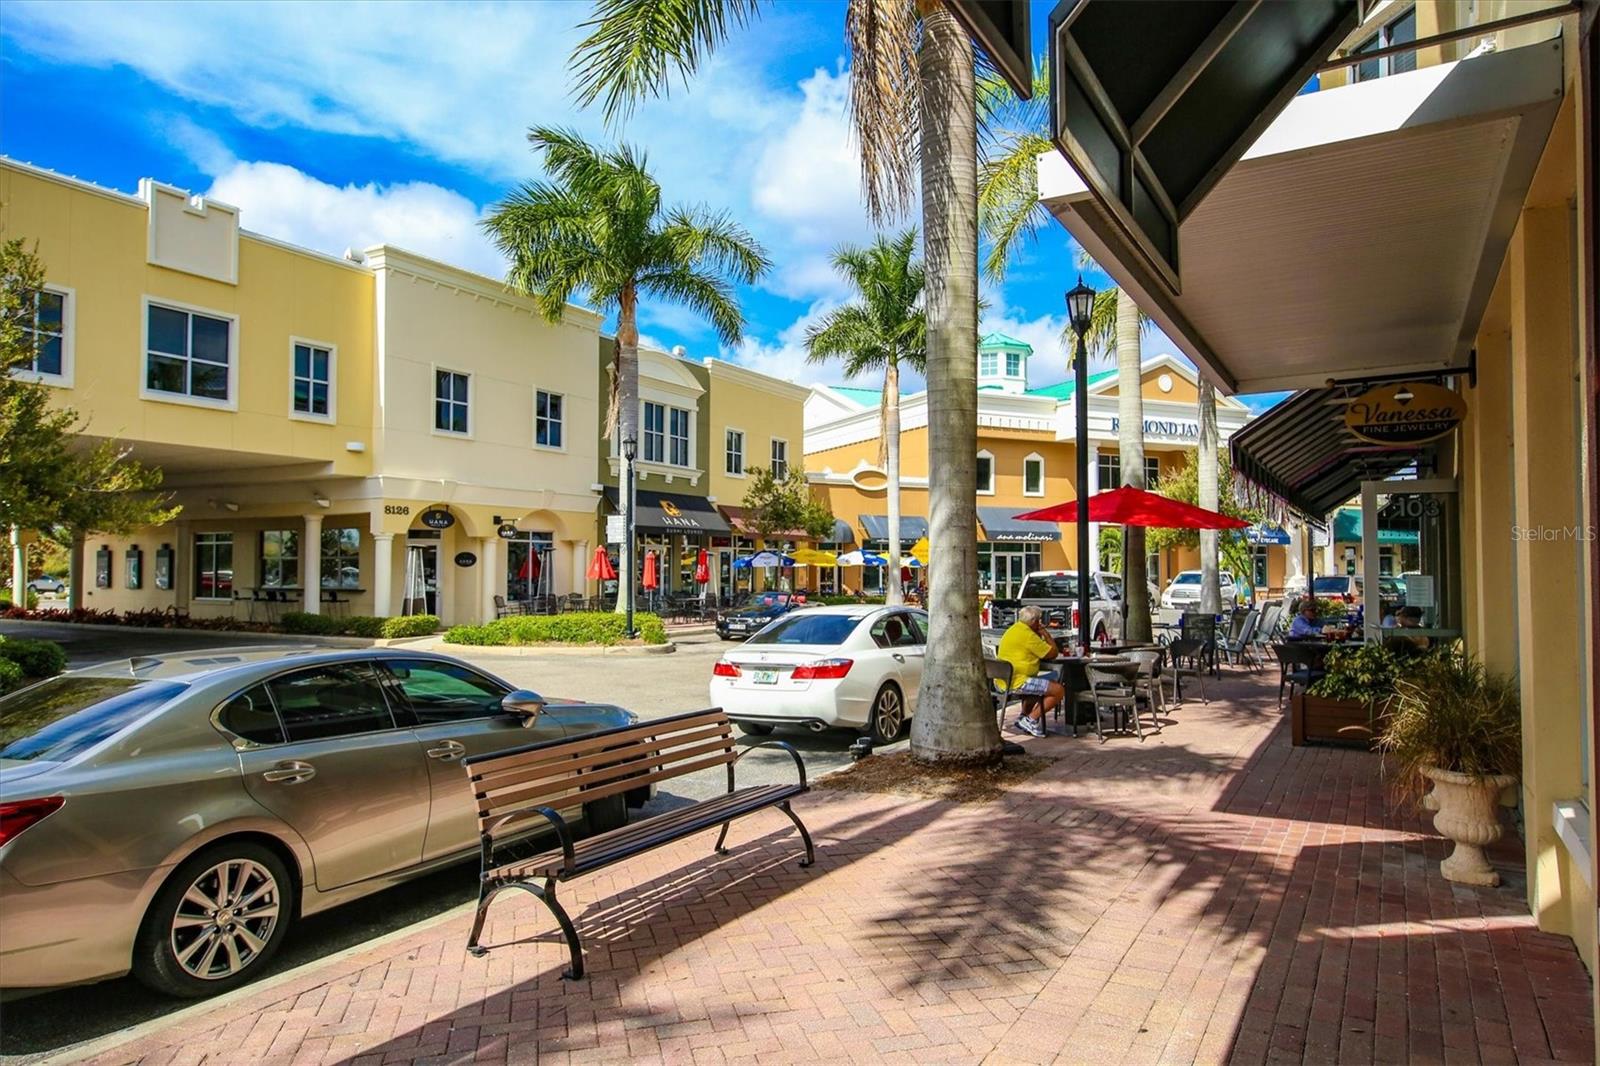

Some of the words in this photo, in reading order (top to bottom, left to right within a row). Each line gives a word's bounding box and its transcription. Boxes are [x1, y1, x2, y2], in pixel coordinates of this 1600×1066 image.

[1351, 402, 1455, 424] Vanessa
[1111, 417, 1178, 435] RMOND
[1394, 422, 1449, 433] JEWELRY
[384, 505, 409, 515] 8126
[661, 516, 700, 527] HANA
